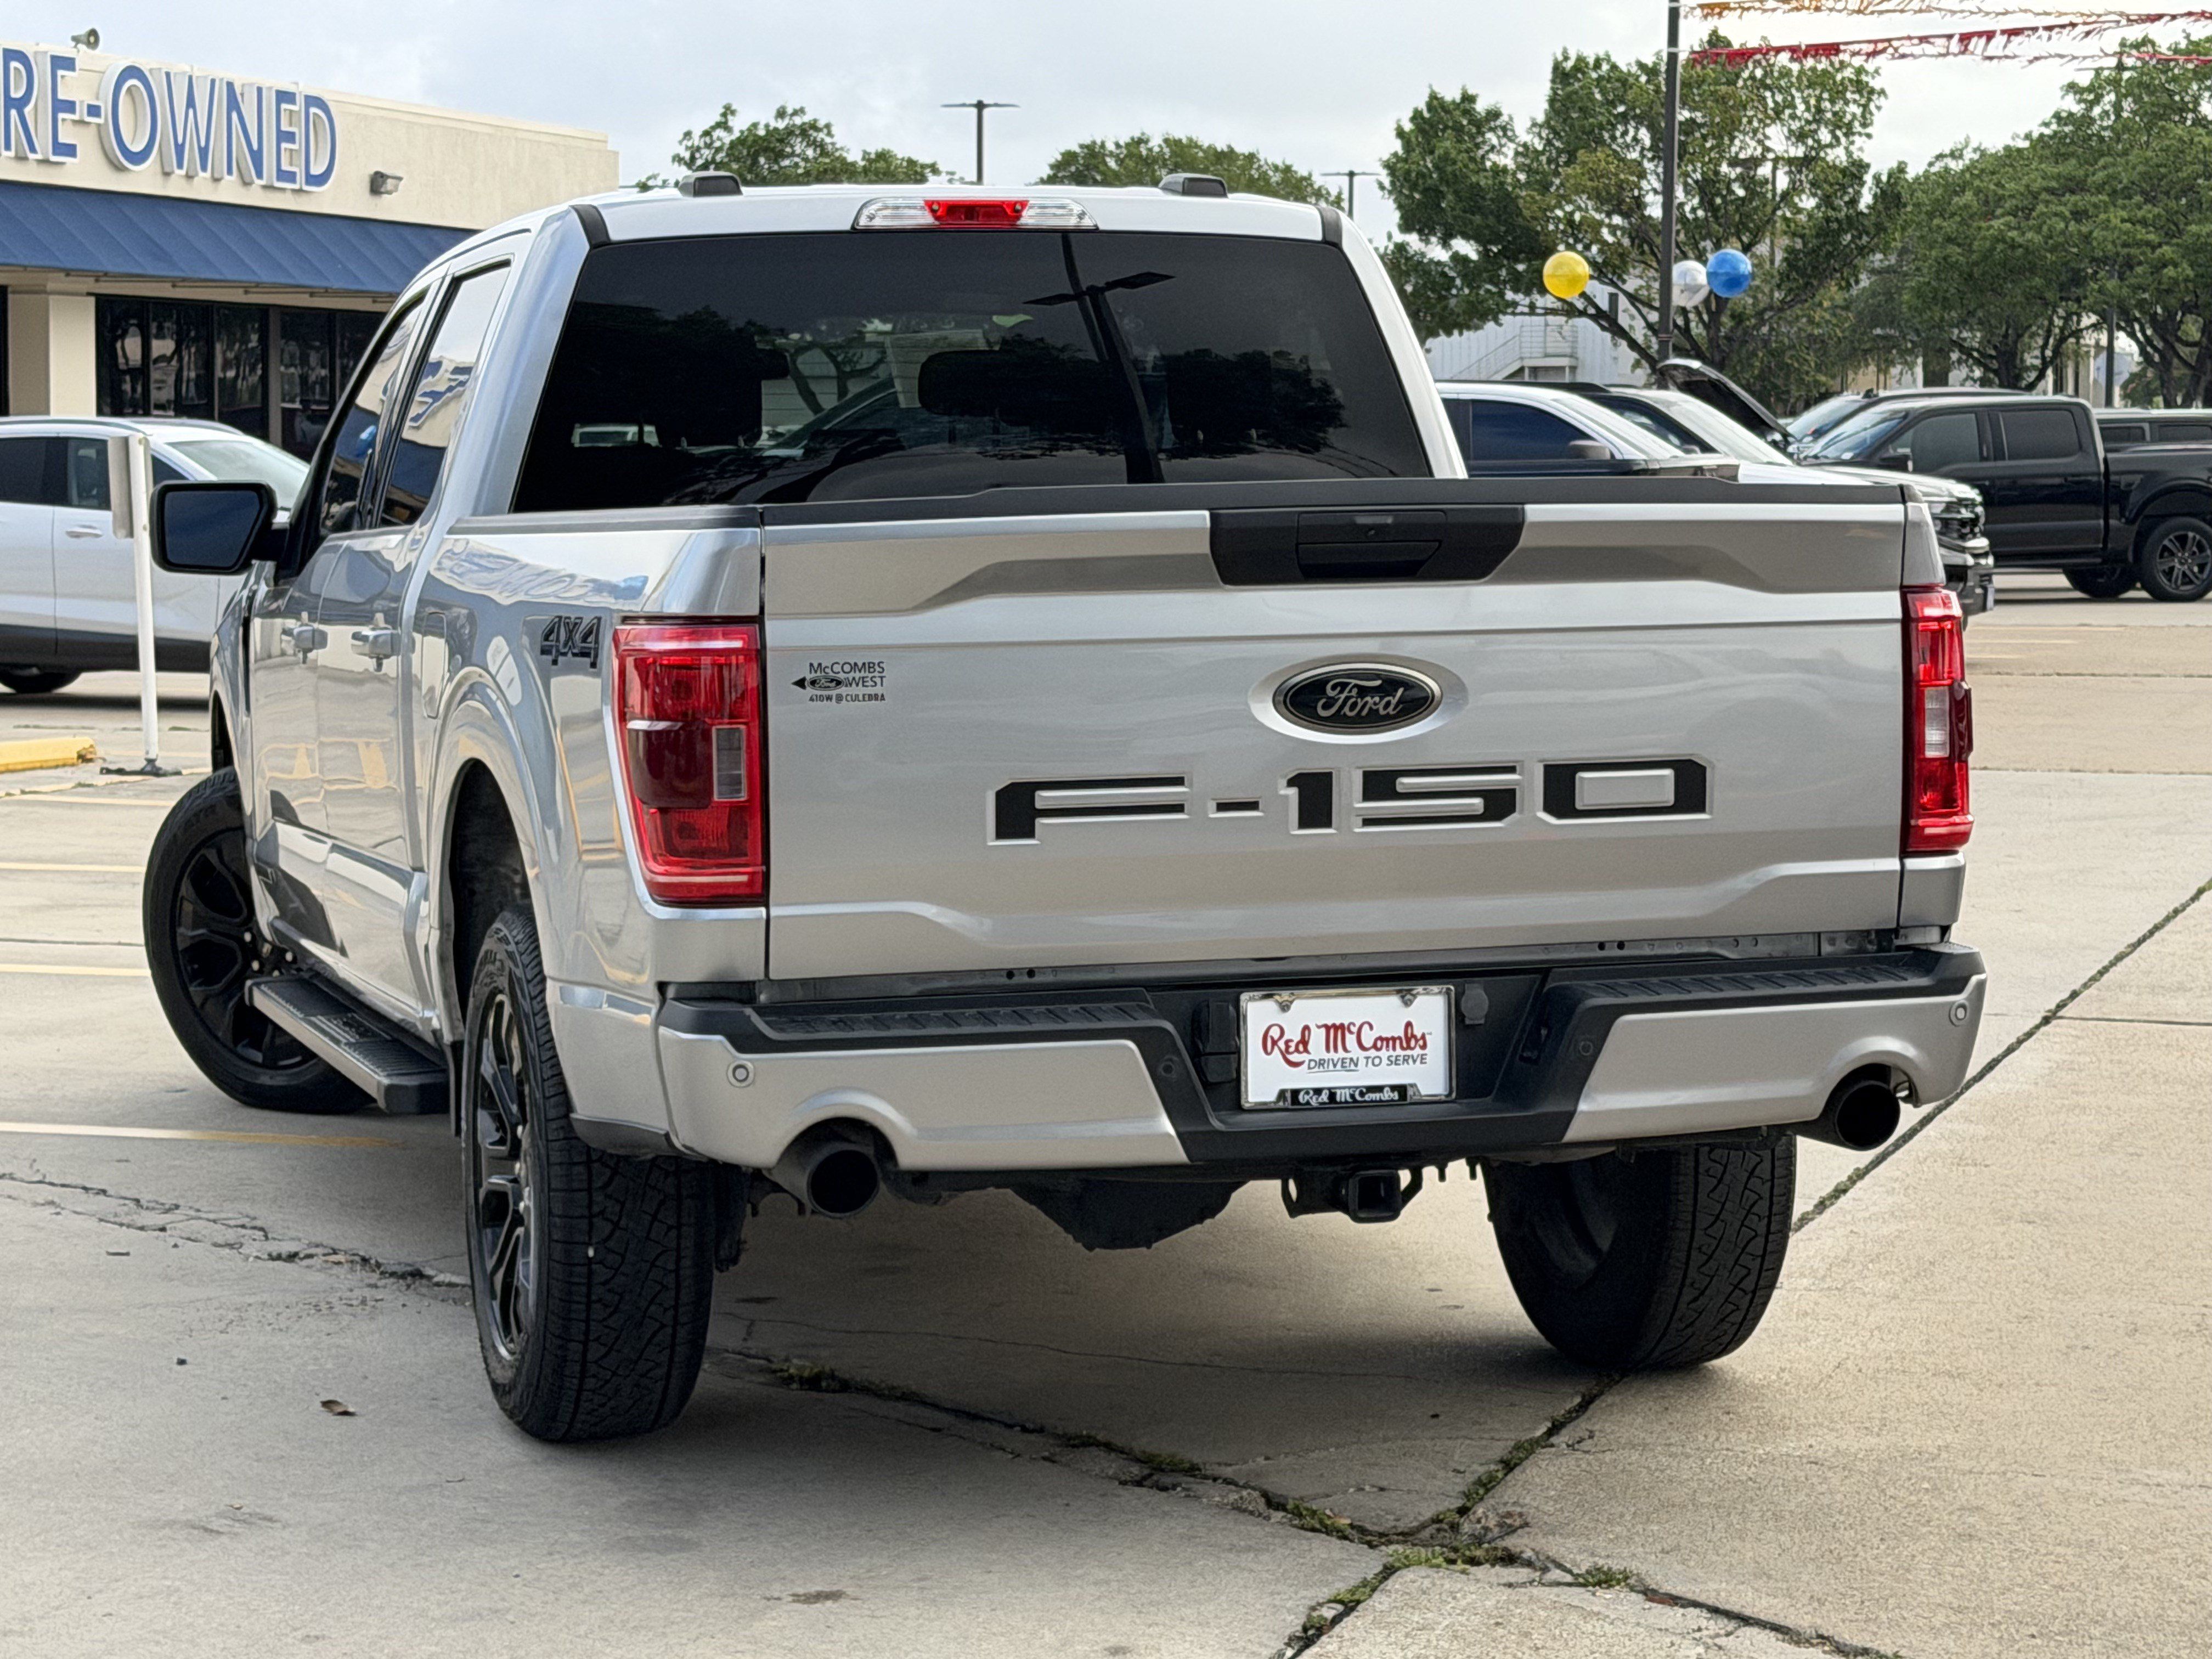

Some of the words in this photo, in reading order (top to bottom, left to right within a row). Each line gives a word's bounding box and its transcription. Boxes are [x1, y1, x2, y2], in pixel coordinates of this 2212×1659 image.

[809, 661, 885, 674] McCOMBS
[844, 675, 887, 687] WEST
[1317, 678, 1404, 717] Ford
[988, 757, 1711, 844] F-150
[1261, 1023, 1312, 1068] Red
[1315, 1020, 1427, 1054] McCombs
[1307, 1056, 1359, 1070] DRIVEN
[1363, 1056, 1383, 1068] TO
[1386, 1053, 1428, 1066] SERVE
[1298, 1088, 1329, 1107] Red
[1331, 1086, 1399, 1103] McCombs
